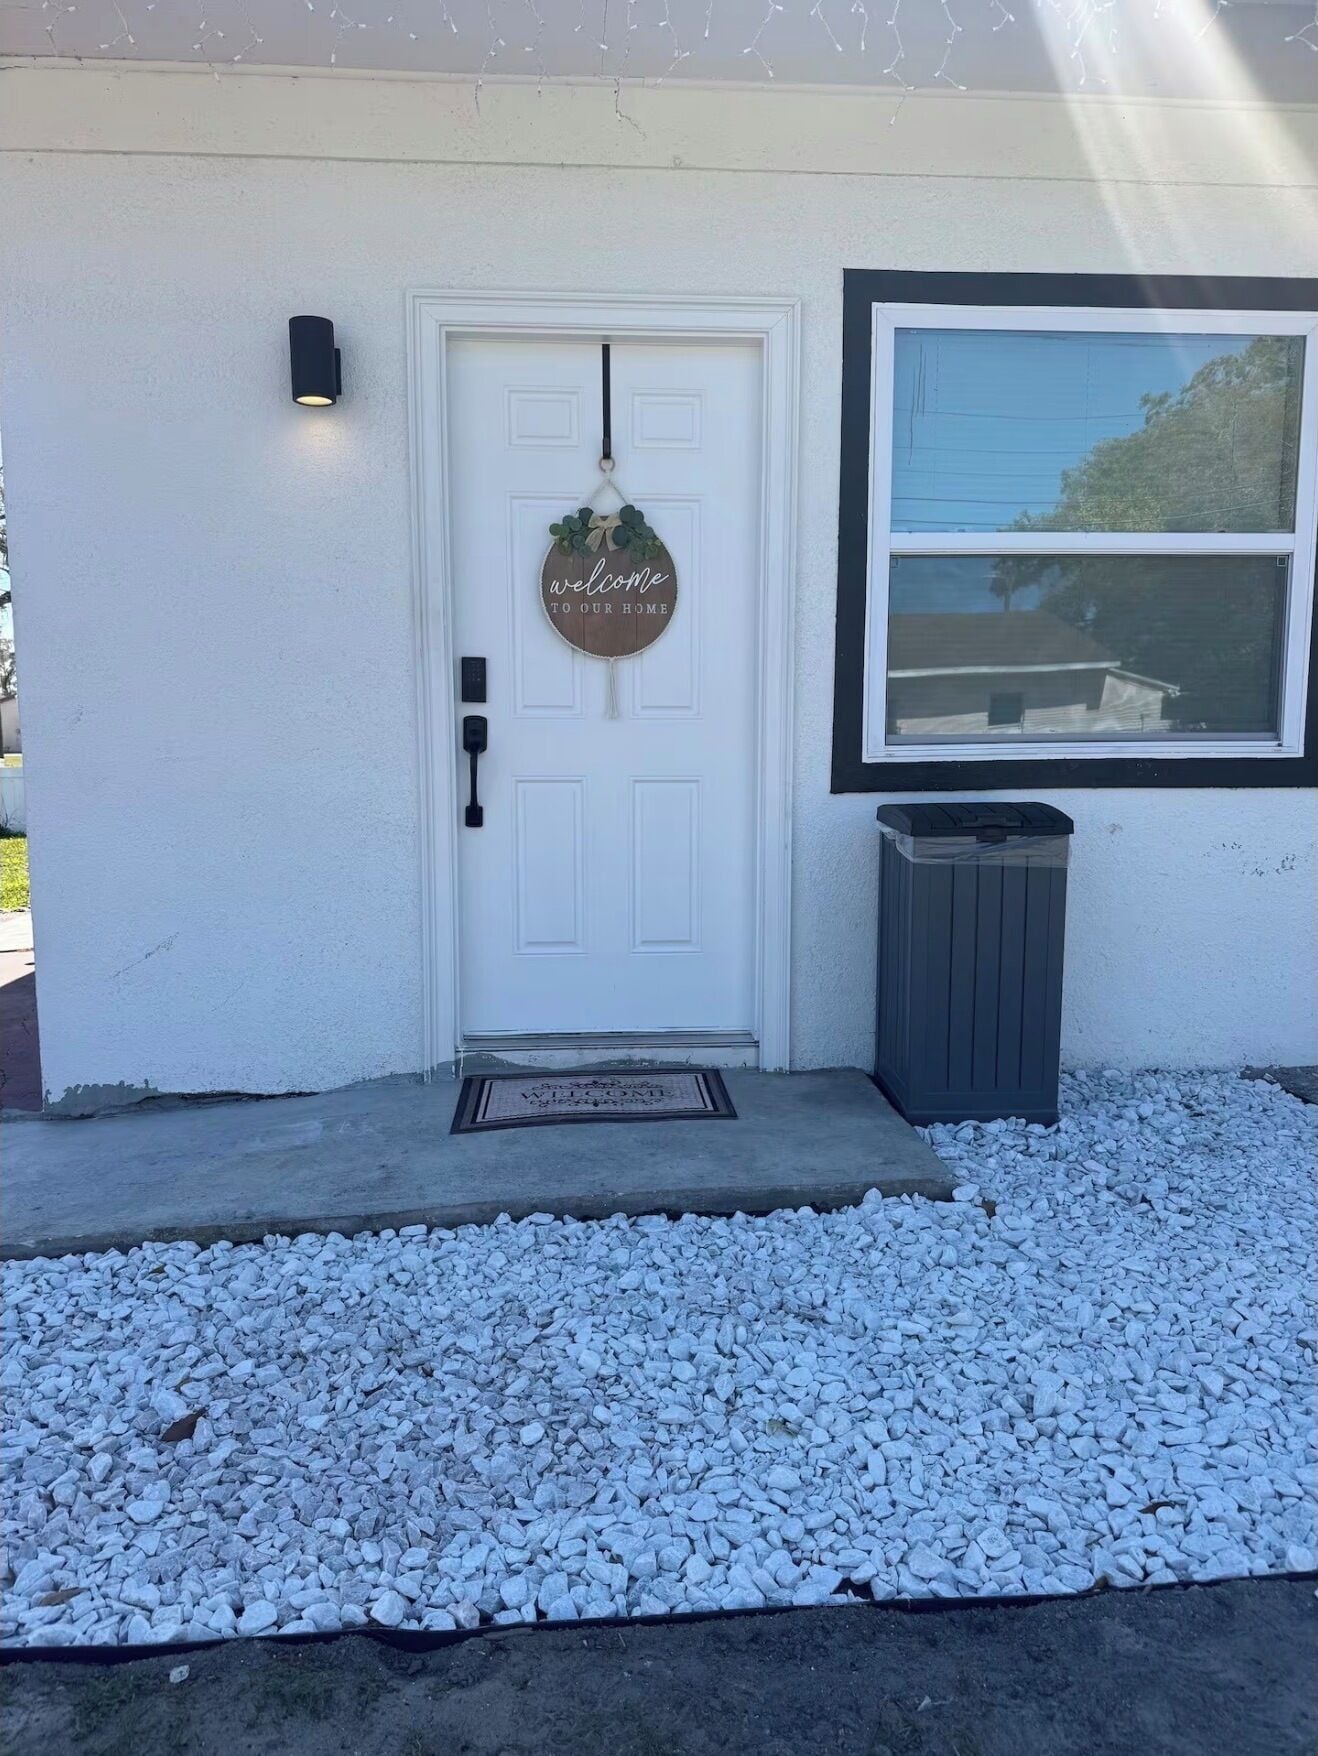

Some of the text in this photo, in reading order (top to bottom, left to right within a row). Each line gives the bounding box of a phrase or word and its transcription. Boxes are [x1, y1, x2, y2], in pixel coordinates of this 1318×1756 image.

[550, 557, 670, 596] welcome
[551, 602, 669, 614] TO OUR HOME
[521, 1089, 675, 1100] WELCOME
